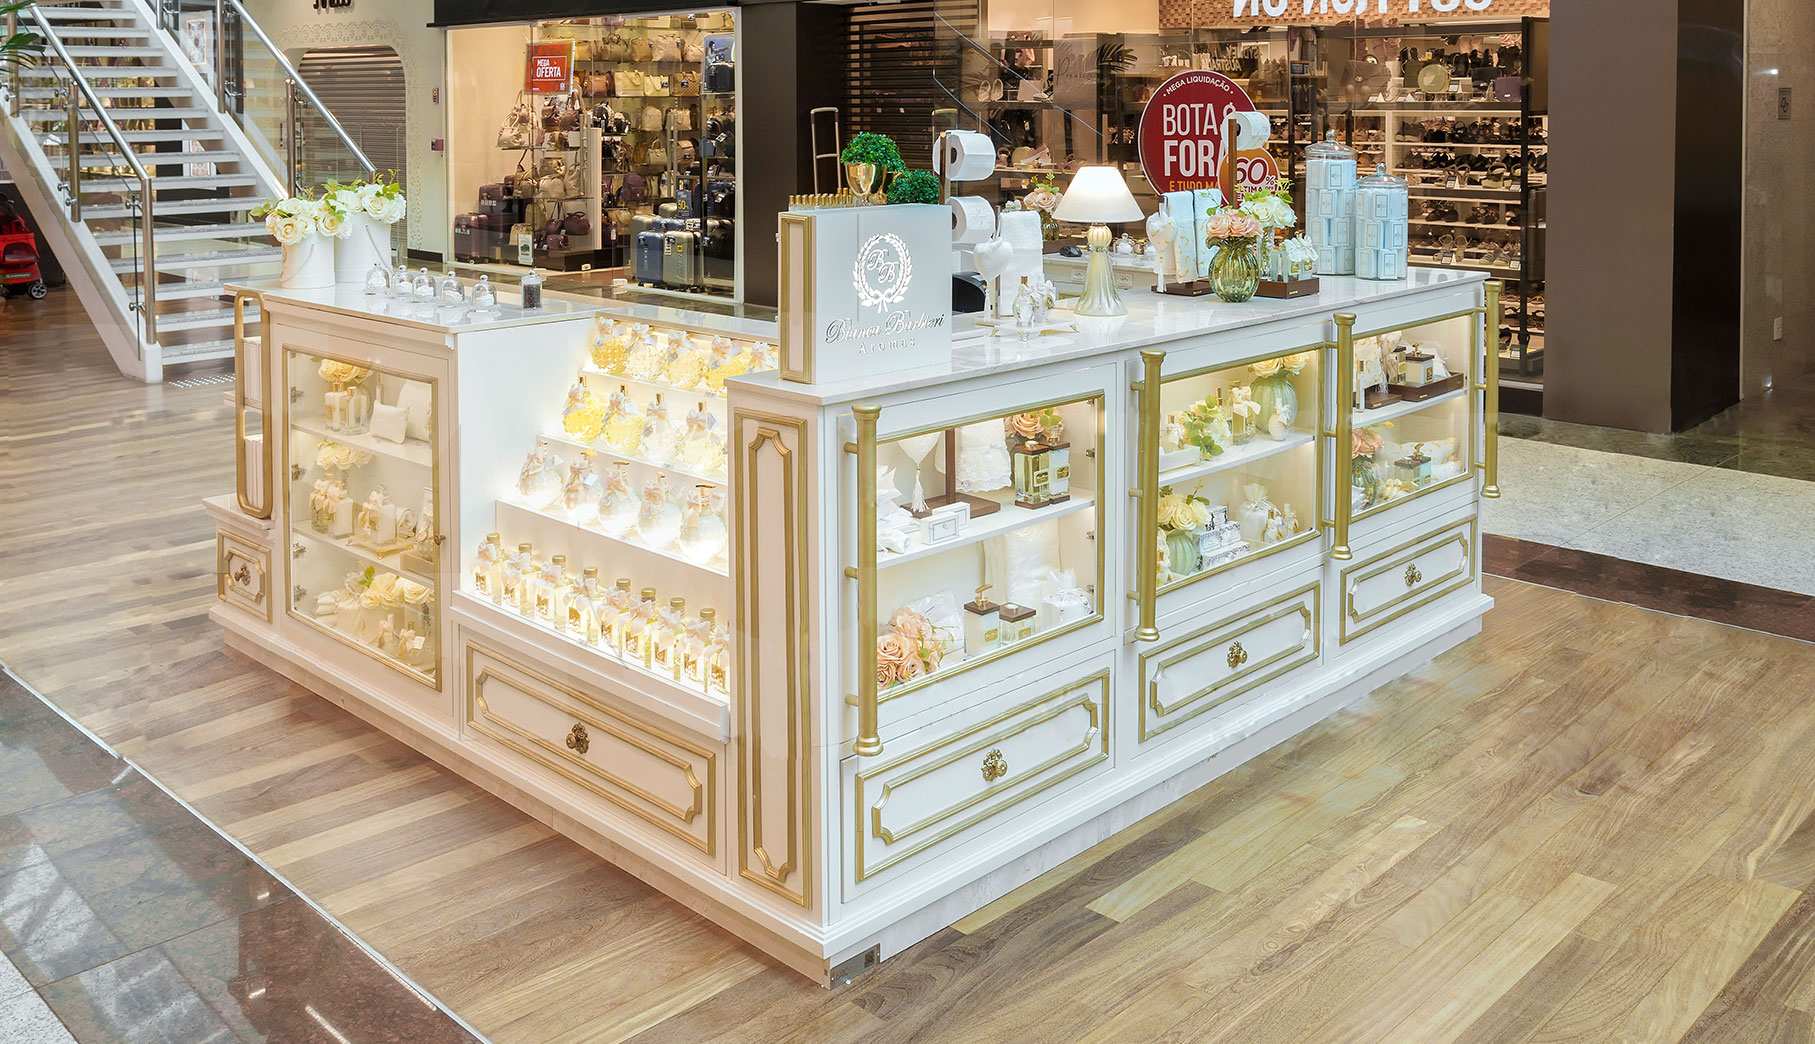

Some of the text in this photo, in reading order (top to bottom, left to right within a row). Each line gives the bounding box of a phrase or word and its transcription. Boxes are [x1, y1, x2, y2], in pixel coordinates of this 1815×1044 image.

[536, 66, 562, 78] OFERTA
[1166, 75, 1230, 95] MEGA LIQUIDAÇÃO
[1162, 103, 1219, 136] BOTA
[1169, 181, 1176, 192] E
[1176, 181, 1203, 191] TUDO
[825, 310, 945, 344] Bianca Barbieri
[858, 337, 916, 355] Aromas
